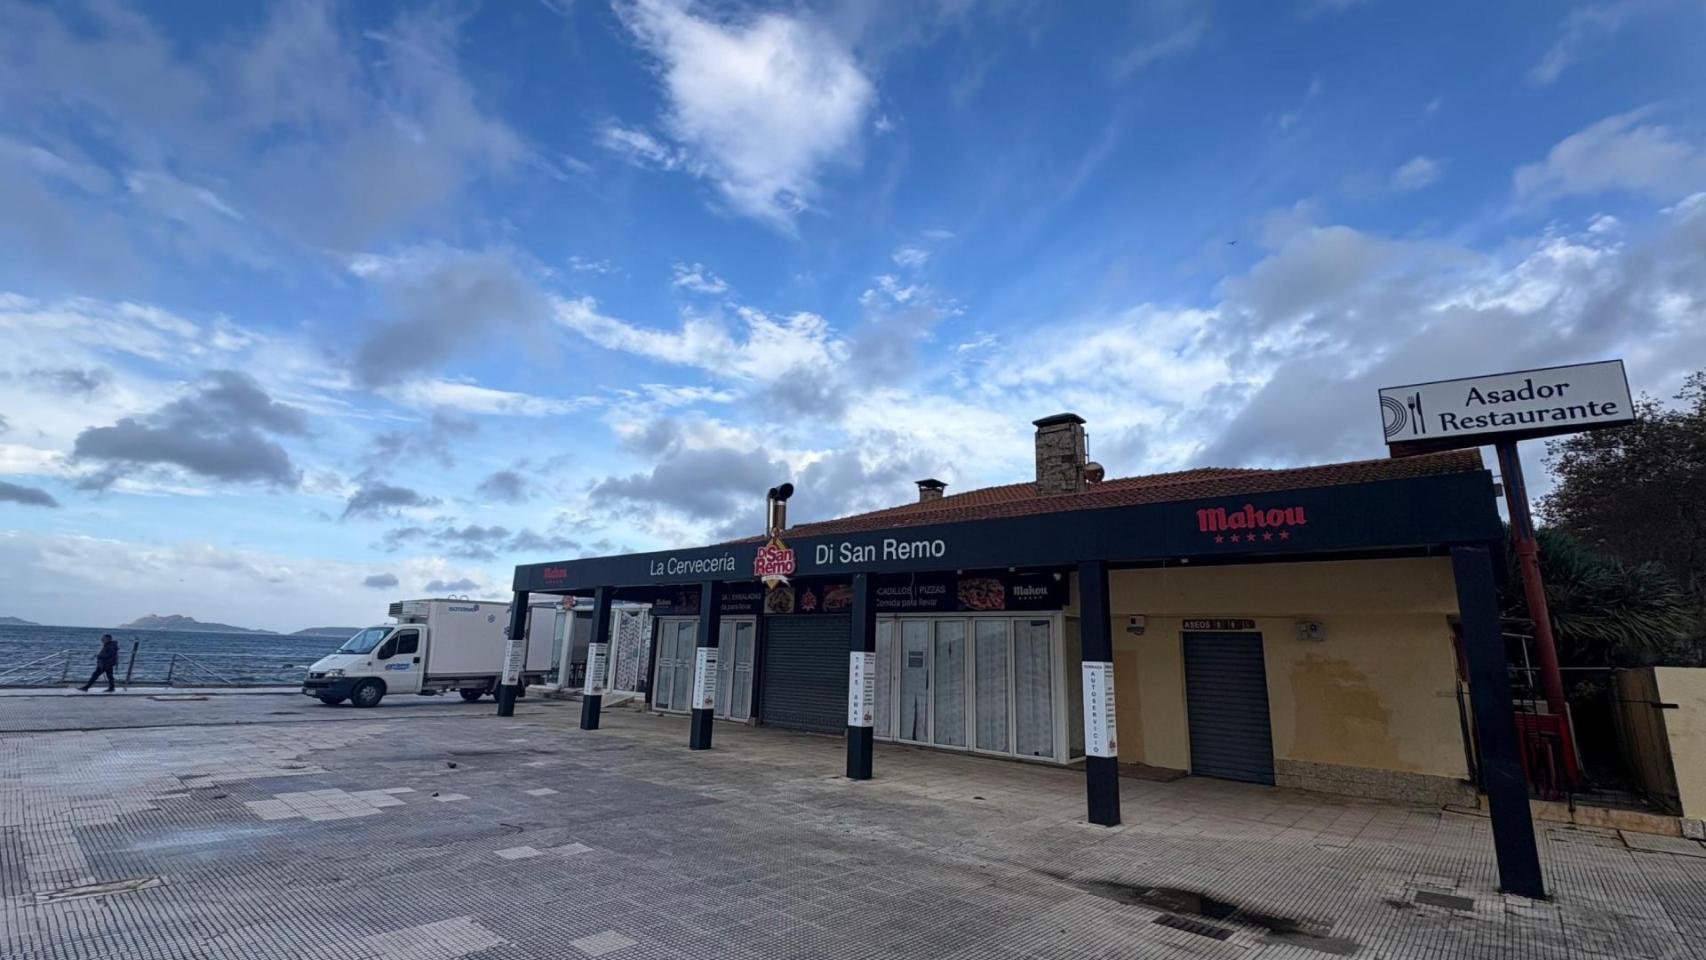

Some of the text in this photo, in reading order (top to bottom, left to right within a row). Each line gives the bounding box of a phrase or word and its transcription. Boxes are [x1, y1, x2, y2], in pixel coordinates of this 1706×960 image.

[1465, 379, 1570, 407] Asador
[1438, 401, 1618, 432] Restaurante
[1196, 503, 1308, 532] Mahou
[767, 546, 792, 562] San
[815, 538, 946, 565] Di San Remo
[650, 552, 735, 576] La Cervecería
[756, 558, 793, 575] Remo
[876, 585, 946, 595] CADILLOS PIZZAS
[1013, 585, 1048, 596] Mahou
[1184, 620, 1211, 629] ASEOS
[1090, 671, 1100, 753] AUTOSERVICIO
